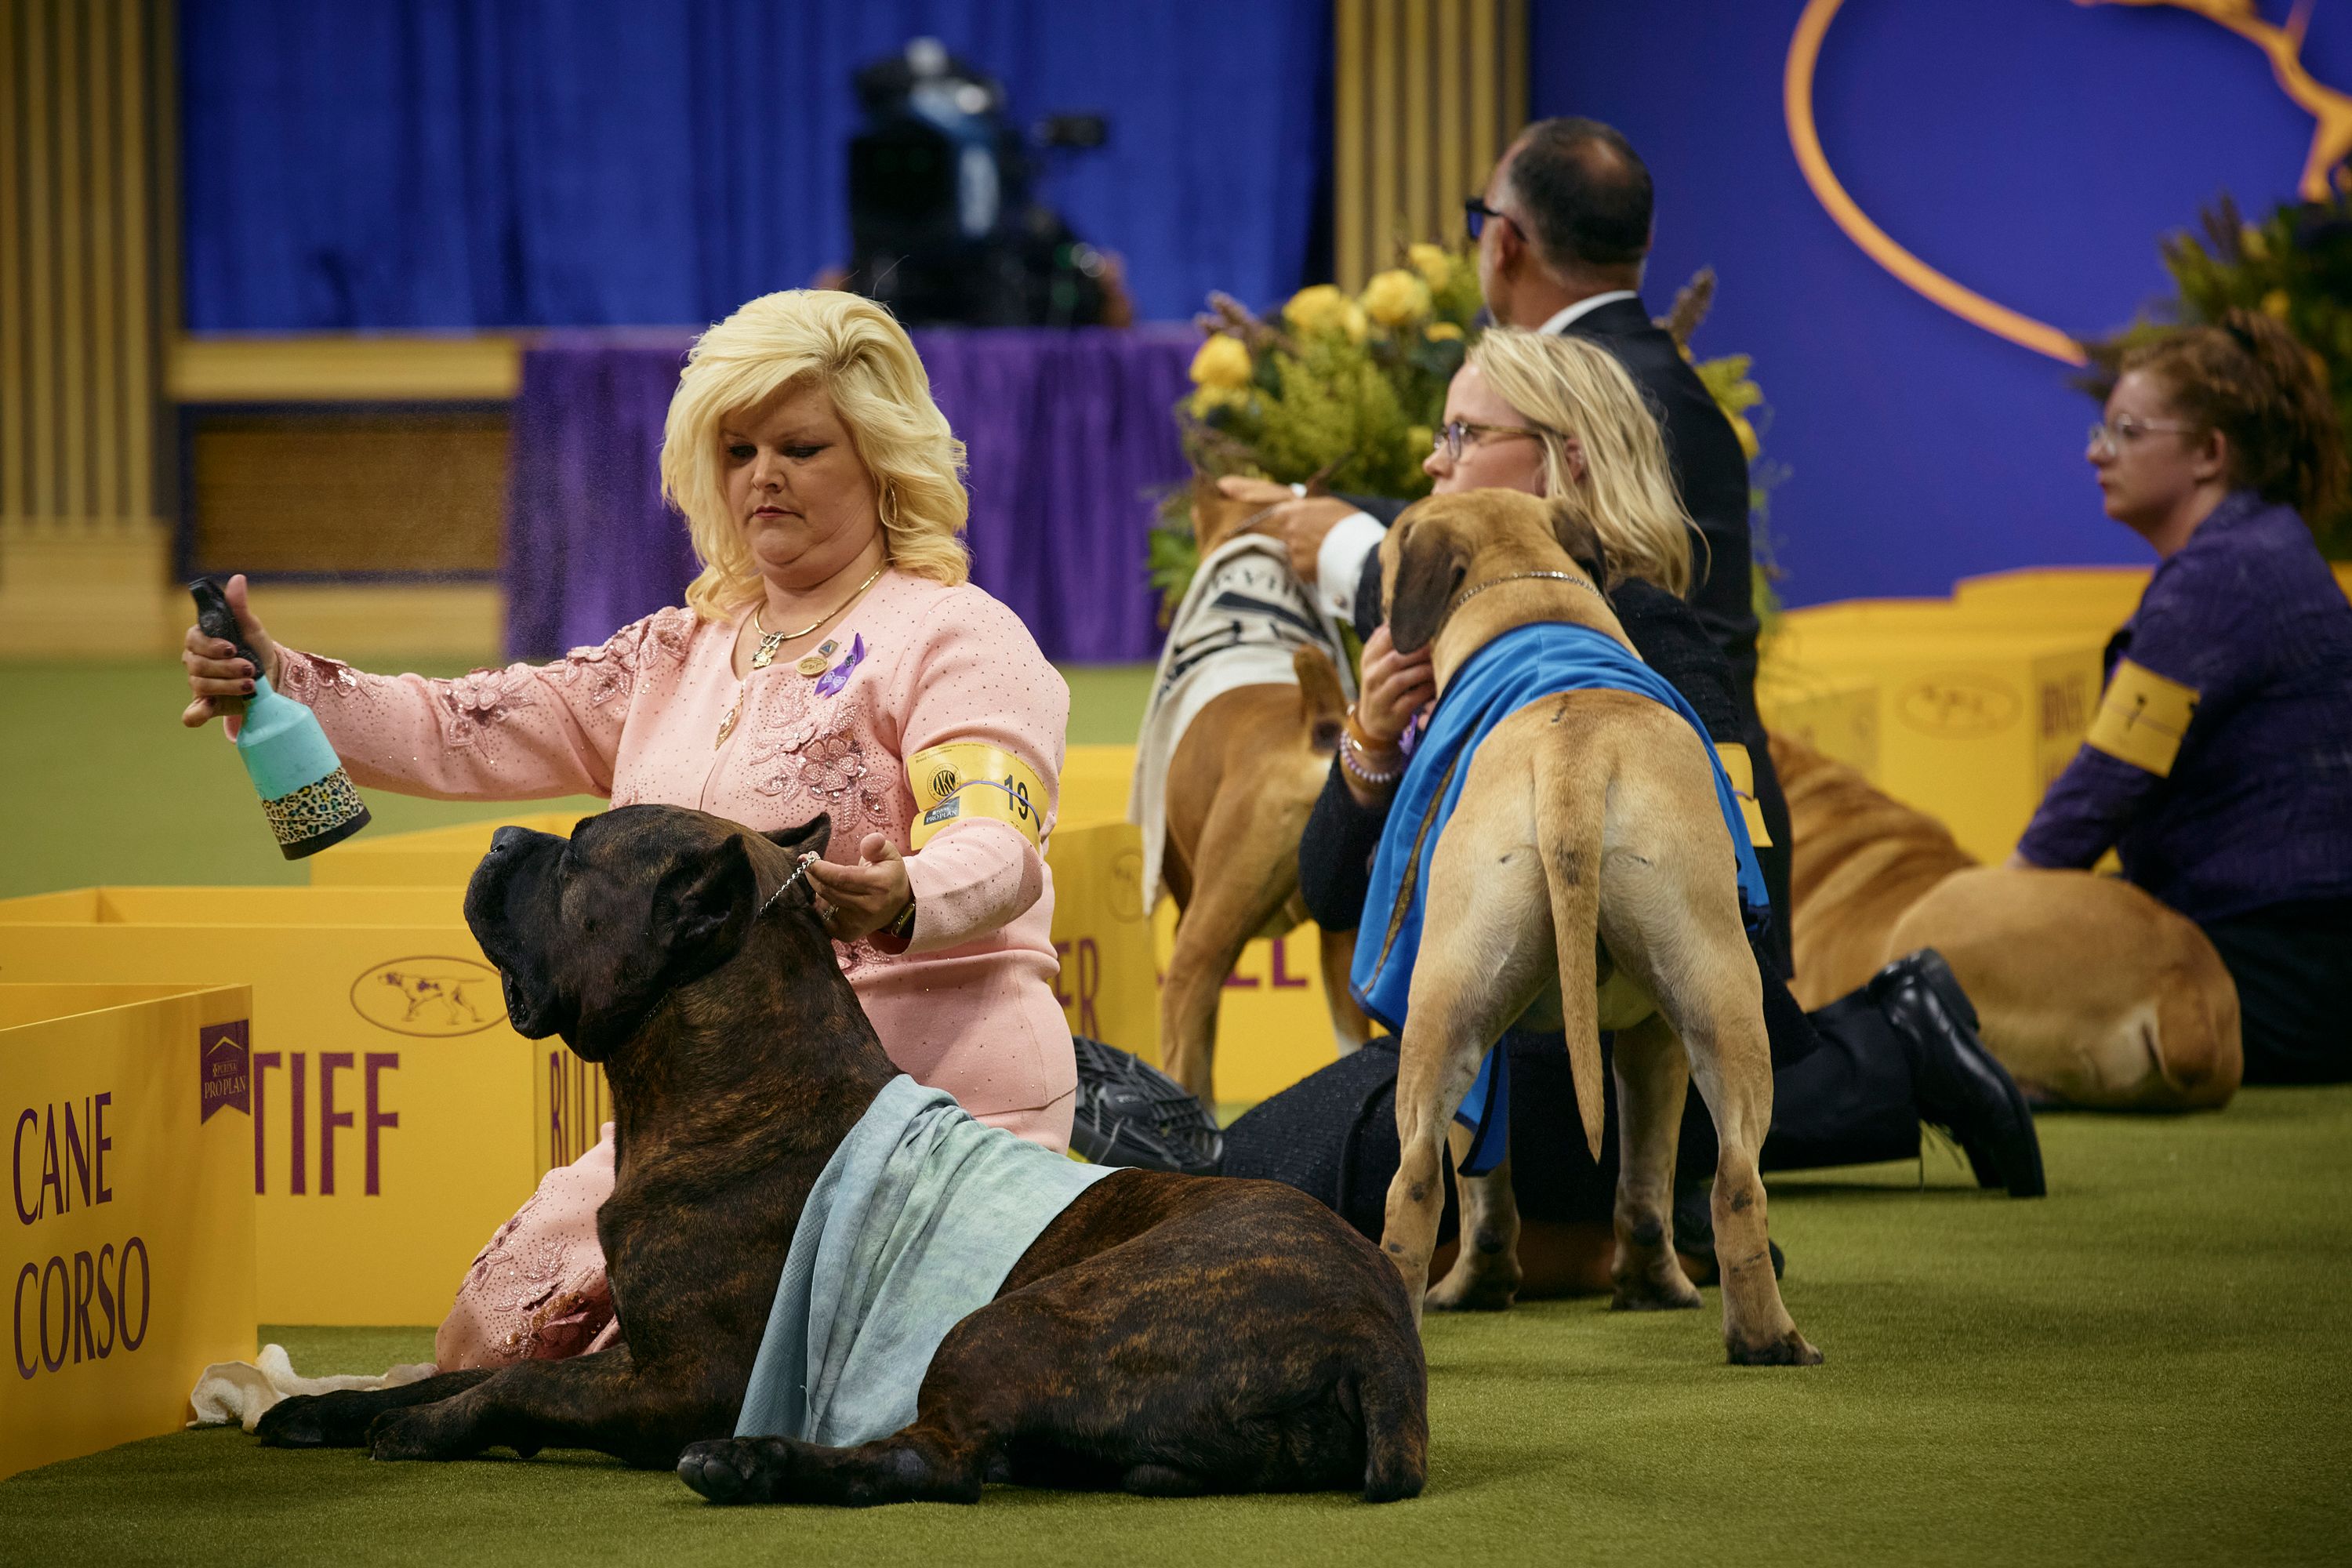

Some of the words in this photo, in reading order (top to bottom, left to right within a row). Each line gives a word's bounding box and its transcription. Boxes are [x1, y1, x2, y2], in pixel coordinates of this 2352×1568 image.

[935, 771, 956, 796] AKC
[1004, 774, 1029, 821] 19
[217, 1063, 237, 1073] PURINA
[13, 1091, 114, 1225] CANE
[13, 1236, 151, 1380] CORSO
